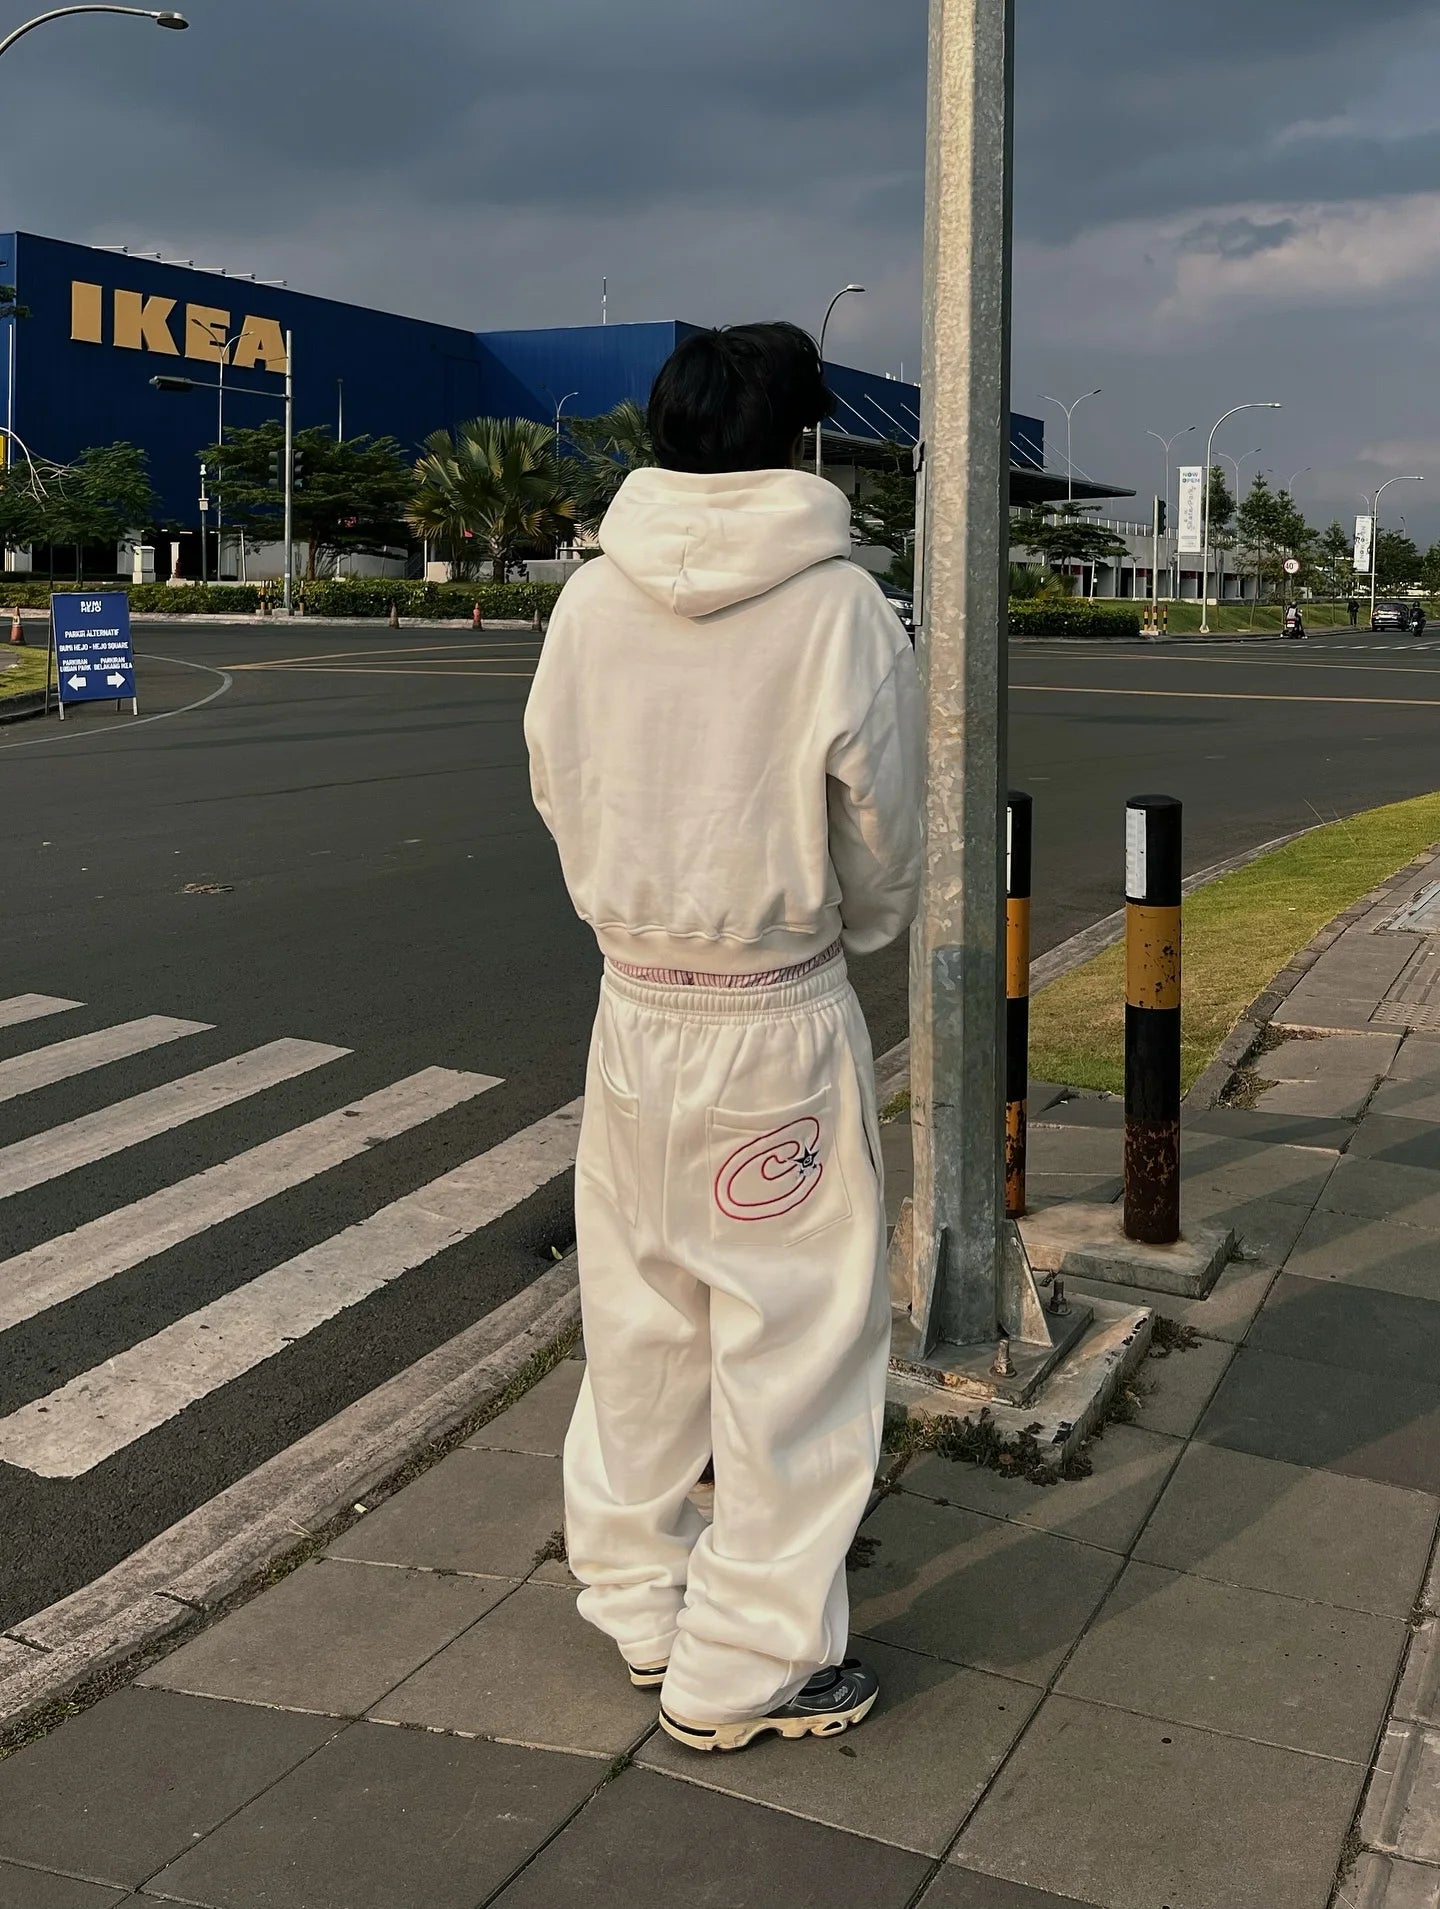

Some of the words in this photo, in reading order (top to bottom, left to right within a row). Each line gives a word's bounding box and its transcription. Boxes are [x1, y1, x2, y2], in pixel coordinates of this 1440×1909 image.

[70, 280, 287, 374] IKEA
[64, 630, 86, 638] PARKIR
[87, 628, 119, 637] ALTERNATIF
[59, 644, 73, 652] BUMI
[73, 643, 88, 651] HEJO
[107, 642, 129, 650] SQUARE
